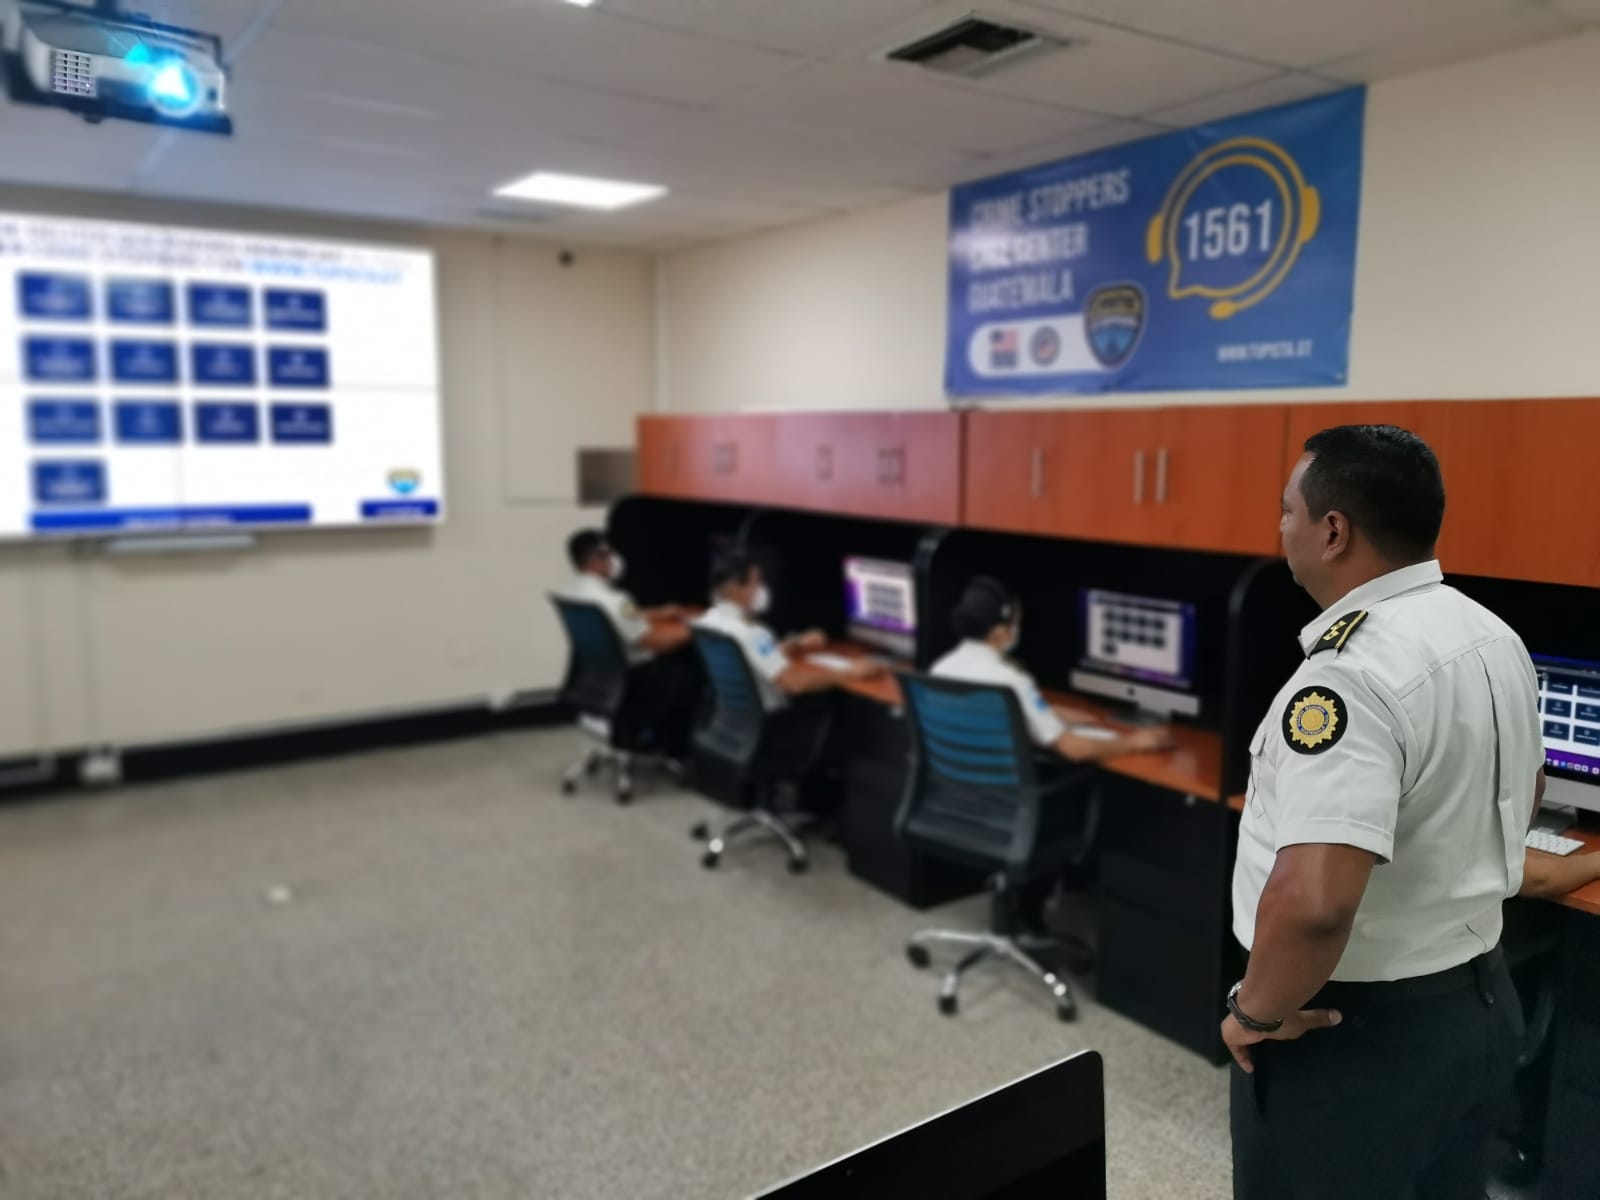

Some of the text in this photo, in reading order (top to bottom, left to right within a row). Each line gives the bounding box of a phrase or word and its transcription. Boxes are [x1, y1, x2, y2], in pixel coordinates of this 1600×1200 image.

[1029, 167, 1131, 222] STOPPERS
[1010, 222, 1089, 265] CENTER
[1183, 199, 1272, 261] 1561
[968, 269, 1075, 314] GUATEMALA
